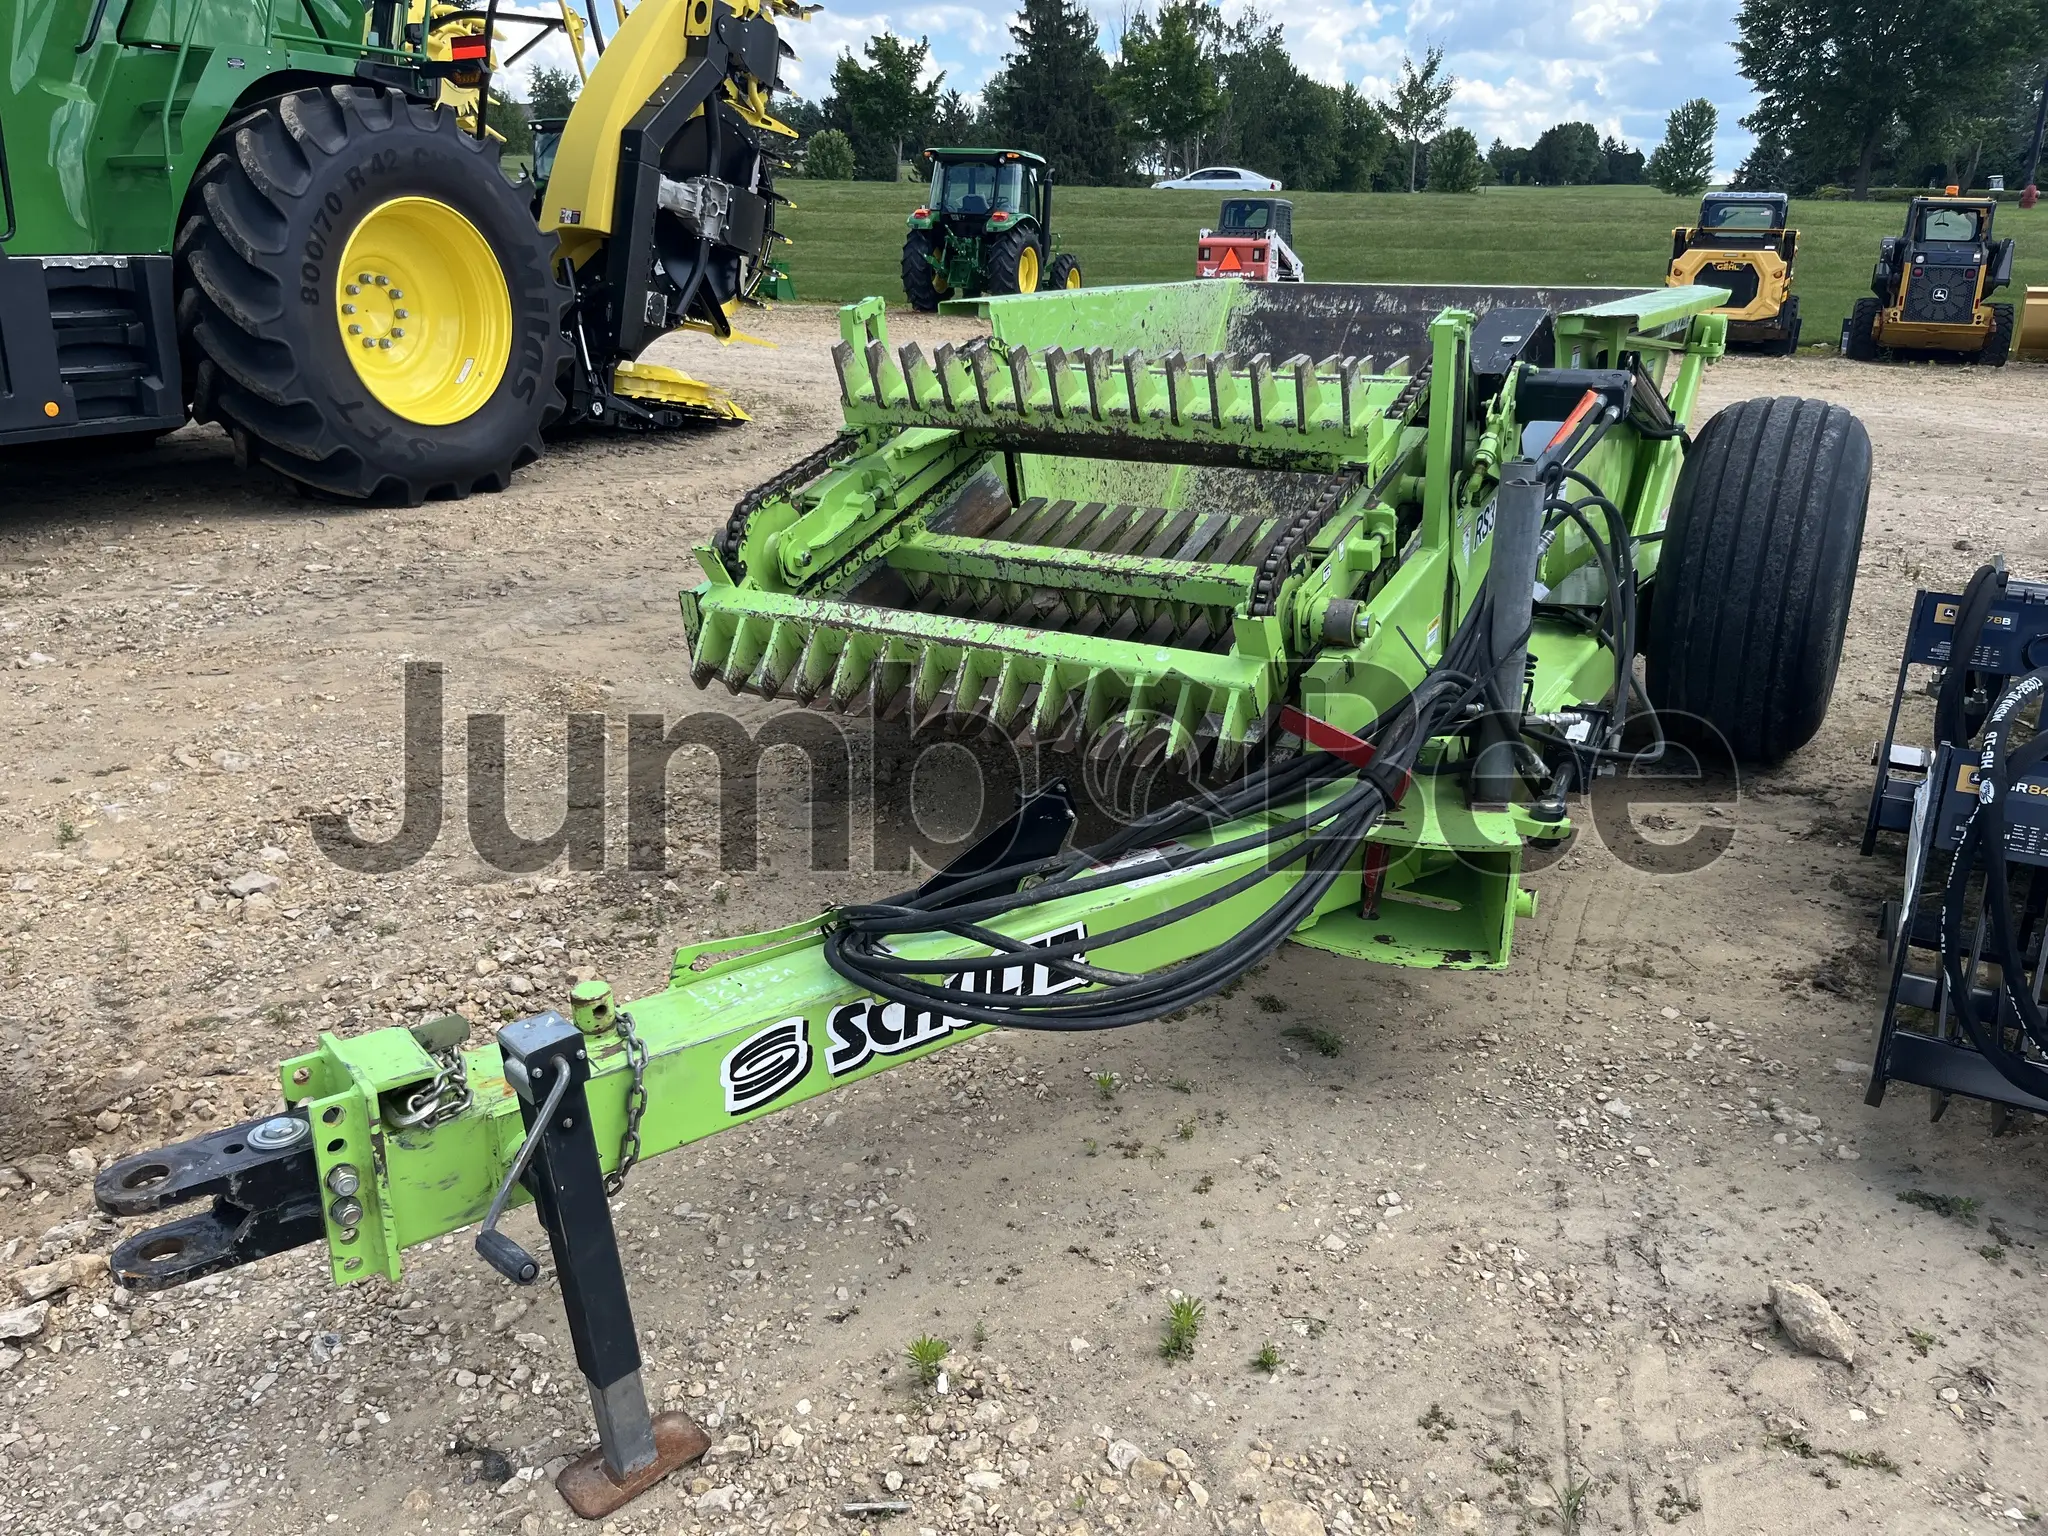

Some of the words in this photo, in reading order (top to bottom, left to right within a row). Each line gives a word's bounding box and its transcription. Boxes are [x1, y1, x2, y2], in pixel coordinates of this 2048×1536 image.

[301, 191, 342, 305] 800/70
[344, 165, 366, 192] R
[371, 148, 398, 174] 42
[1980, 731, 1998, 769] HG-16
[1990, 699, 2016, 723] MSHA
[2010, 782, 2048, 797] R84
